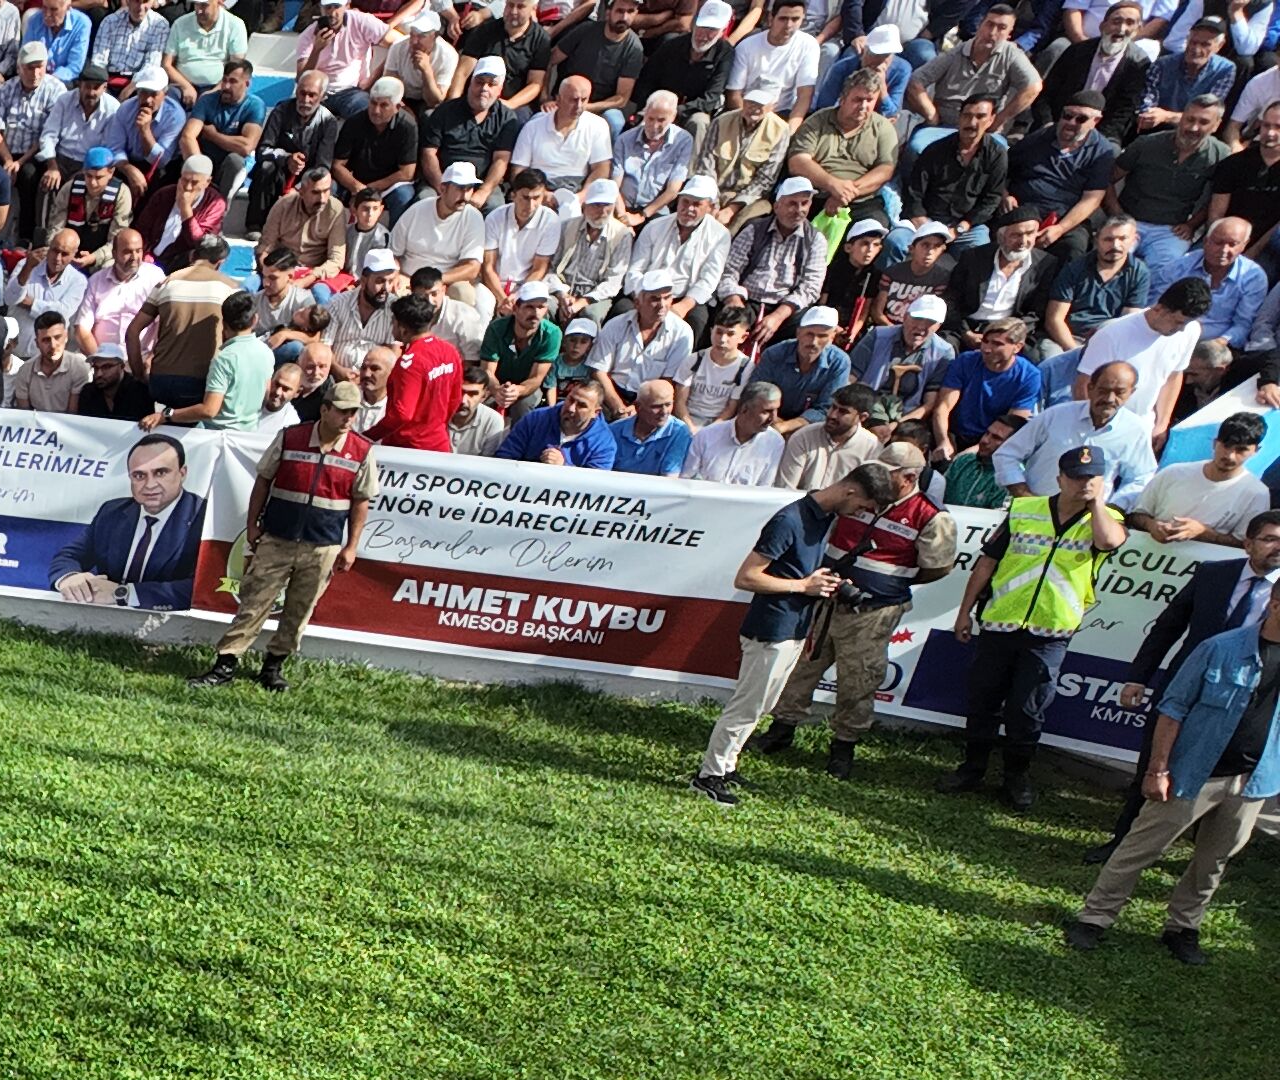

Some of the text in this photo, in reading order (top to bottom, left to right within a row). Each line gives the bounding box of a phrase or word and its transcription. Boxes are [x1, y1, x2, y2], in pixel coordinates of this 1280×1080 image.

[368, 493, 705, 548] ENÖR ve İDARECİLERİMİZE
[412, 473, 652, 520] SPORCULARIMIZA,
[362, 518, 614, 572] Başarılar Dilerim
[392, 578, 666, 633] AHMET KUYBU
[438, 610, 605, 645] KMESOB BAŞKANI
[1090, 705, 1147, 728] KMTS
